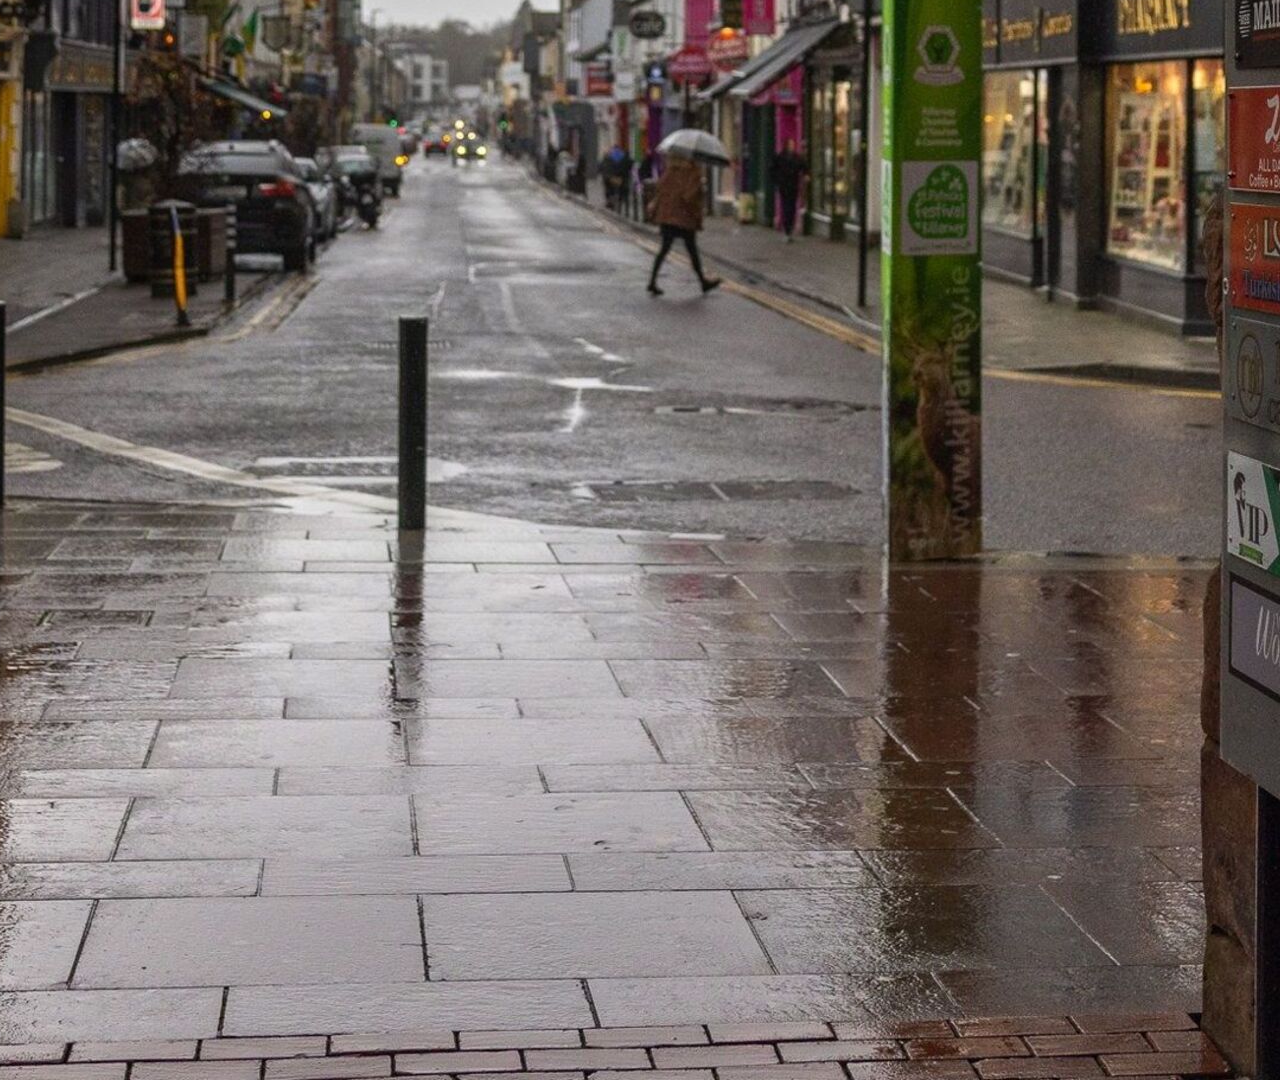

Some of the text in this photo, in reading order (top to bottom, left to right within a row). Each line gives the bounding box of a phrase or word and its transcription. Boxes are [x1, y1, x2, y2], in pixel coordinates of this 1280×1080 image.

[1258, 158, 1272, 172] ALL
[1249, 174, 1269, 188] Coffee
[1236, 499, 1269, 547] VIP
